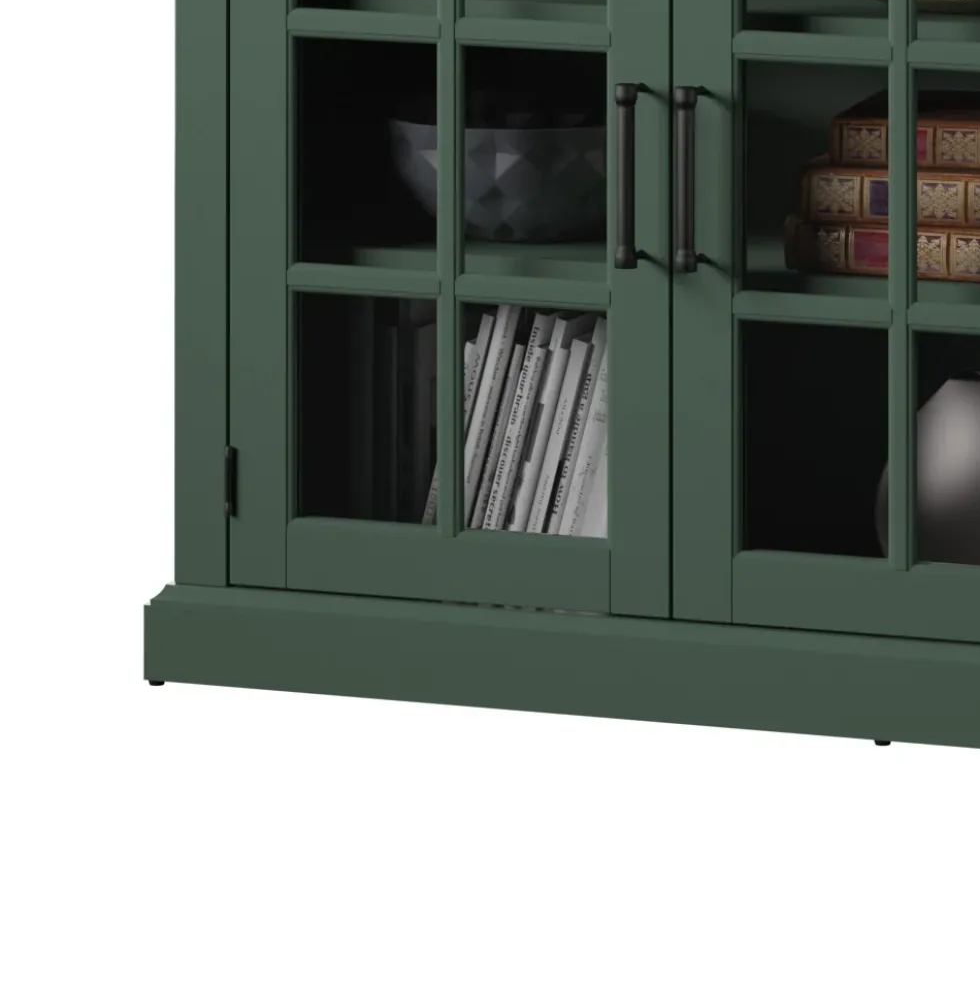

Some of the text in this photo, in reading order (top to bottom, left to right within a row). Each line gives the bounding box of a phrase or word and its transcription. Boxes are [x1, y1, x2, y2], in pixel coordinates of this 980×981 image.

[526, 326, 540, 362] Inside
[518, 364, 530, 391] your
[510, 394, 523, 426] brain
